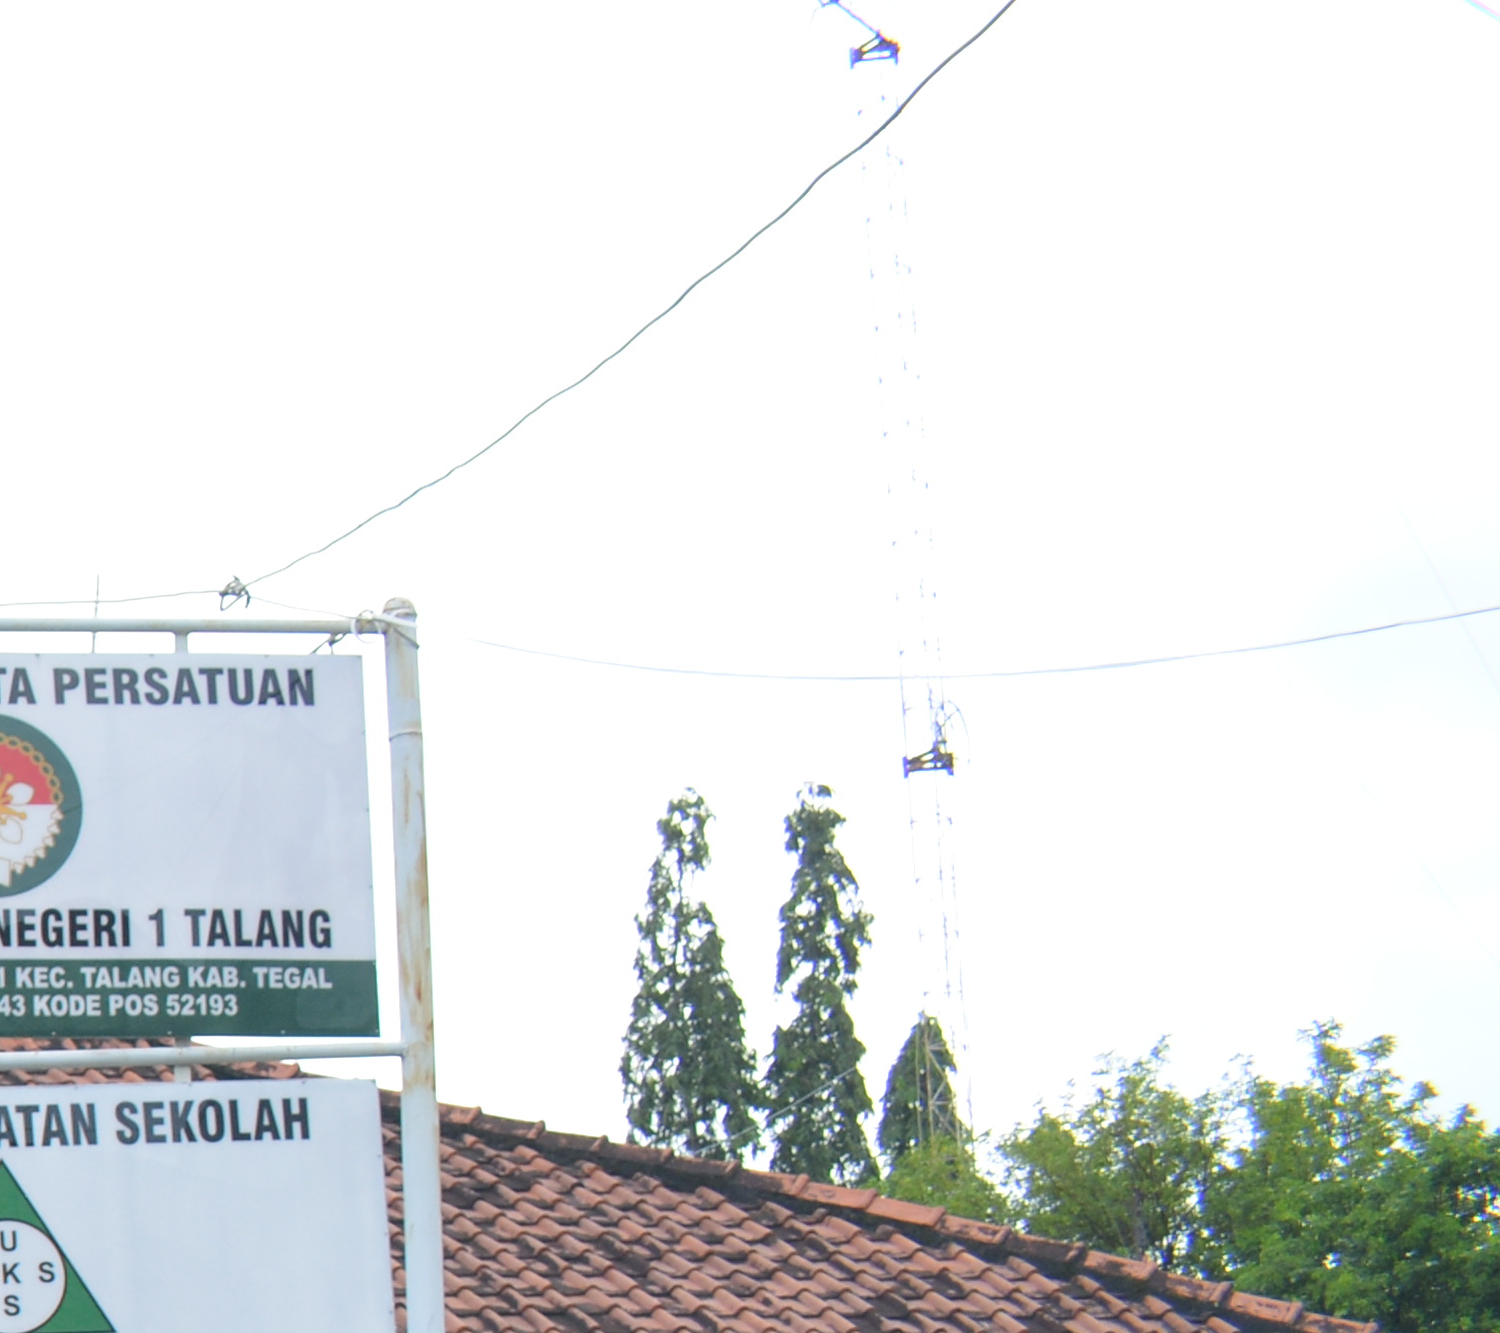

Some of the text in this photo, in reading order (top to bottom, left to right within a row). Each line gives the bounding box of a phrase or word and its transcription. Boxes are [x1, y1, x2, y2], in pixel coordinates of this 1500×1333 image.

[54, 668, 314, 706] PERSATUAN
[149, 909, 164, 947] 1
[185, 910, 331, 948] TALANG
[34, 995, 101, 1016] KODE
[109, 994, 158, 1016] POS
[167, 994, 237, 1015] 52193
[116, 1098, 309, 1144] SEKOLAH
